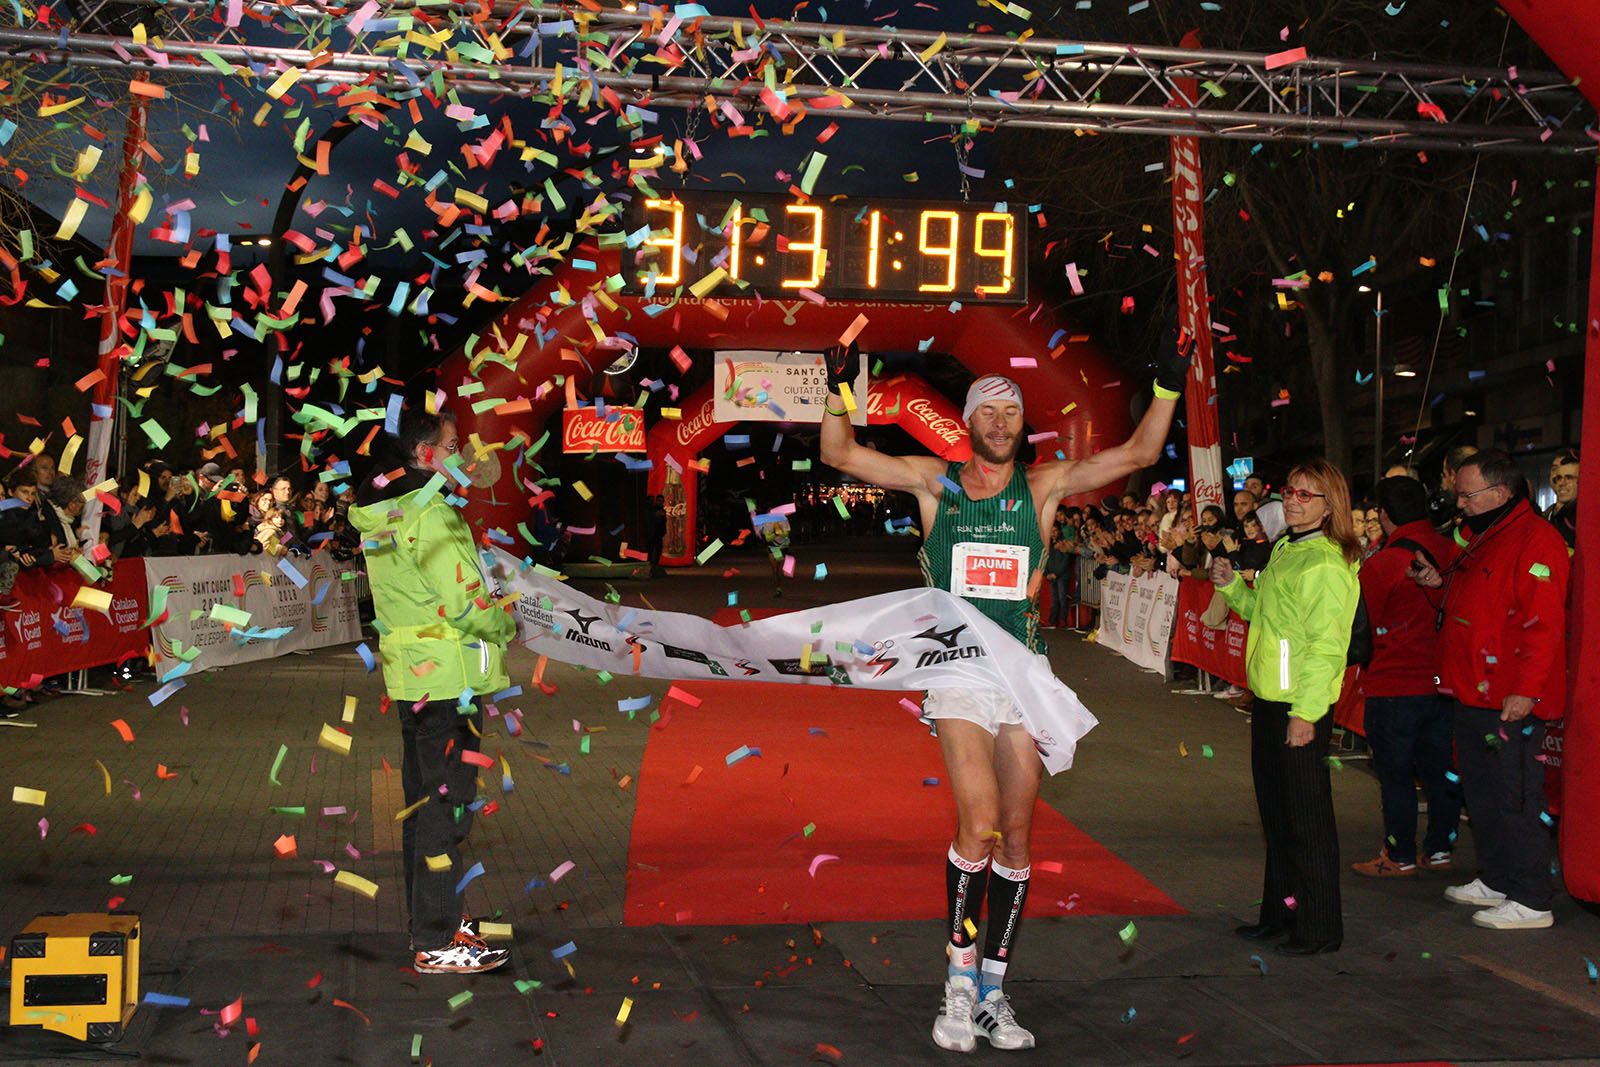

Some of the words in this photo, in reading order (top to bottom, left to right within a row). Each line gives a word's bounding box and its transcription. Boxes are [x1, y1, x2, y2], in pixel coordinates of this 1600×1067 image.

[786, 368, 814, 376] SANT
[802, 377, 828, 386] 201
[784, 386, 814, 395] CIUTAT
[972, 557, 1013, 570] JAUME
[988, 571, 997, 584] 1
[192, 582, 210, 595] SANT
[211, 579, 231, 593] CUGAT
[520, 604, 554, 623] Occident
[565, 628, 611, 652] MIZUNO
